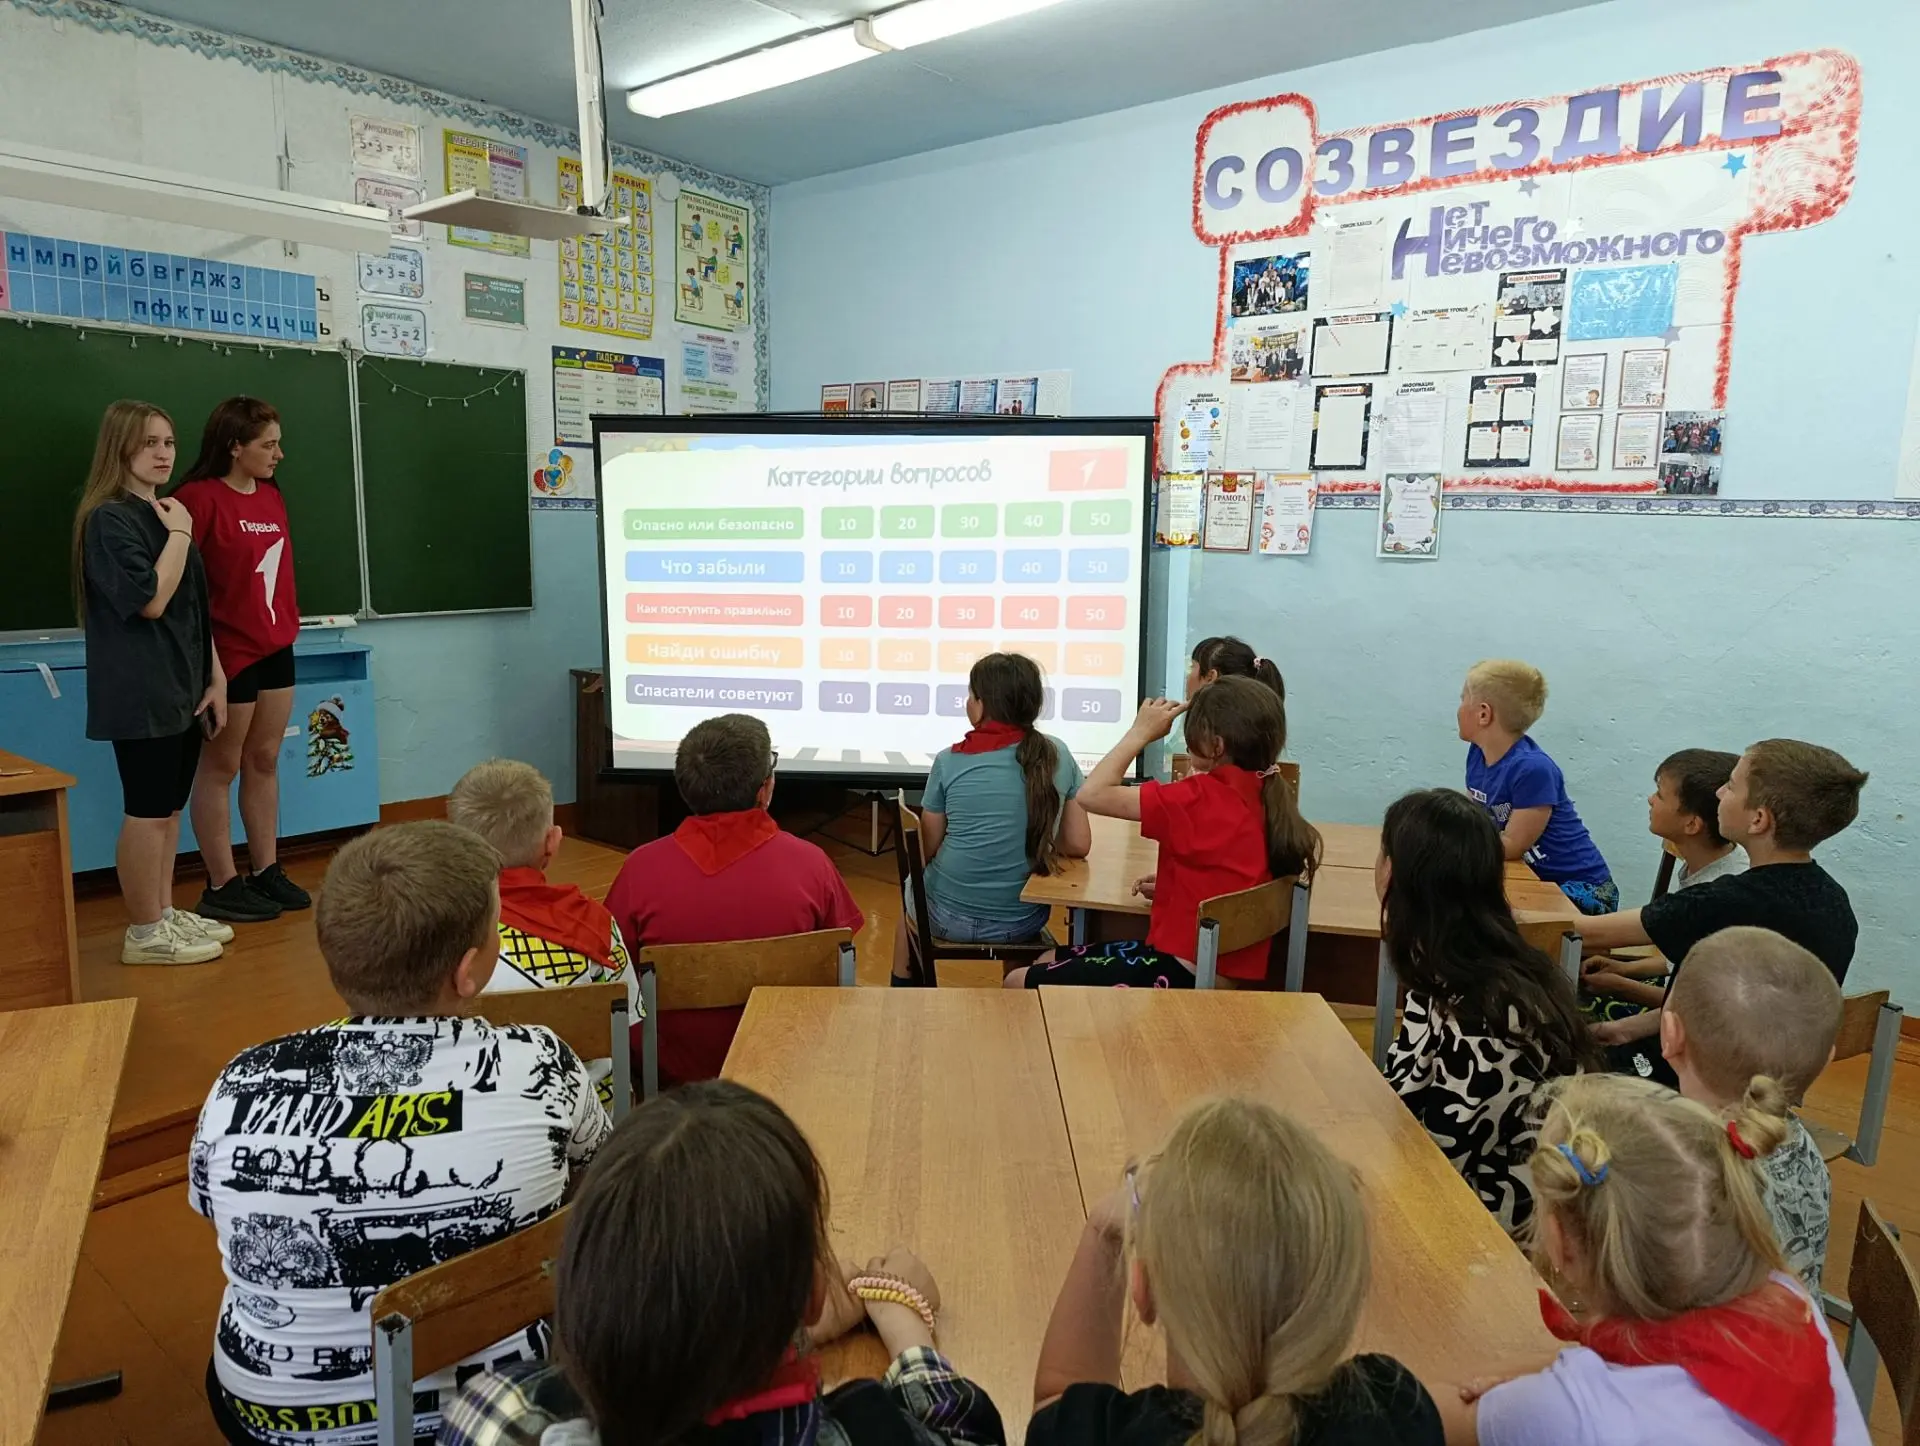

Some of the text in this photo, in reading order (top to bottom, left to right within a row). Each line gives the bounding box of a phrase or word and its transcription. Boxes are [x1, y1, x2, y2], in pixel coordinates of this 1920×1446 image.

[1204, 70, 1783, 211] СОЗВЕЗДИЕ
[613, 175, 646, 189] ЛФАВИТ
[366, 264, 373, 276] 5
[376, 268, 384, 276] +
[387, 266, 395, 279] 3
[409, 269, 417, 282] 8
[370, 325, 378, 338] 5
[391, 326, 398, 339] 3
[402, 330, 409, 338] =
[413, 329, 420, 341] 2
[596, 352, 625, 364] ПАДЕЖИ
[767, 459, 993, 492] Категории вопросов
[1213, 494, 1247, 503] ГРАМОТА
[238, 518, 281, 534] Первые
[632, 517, 795, 532] Опасно или безопасно
[838, 518, 857, 531] 10
[897, 517, 917, 530] 20
[960, 515, 979, 529] 30
[1022, 514, 1044, 528] 40
[1090, 512, 1111, 526] 50
[660, 559, 767, 575] Что забыли
[838, 562, 856, 575] 10
[897, 562, 916, 575] 20
[958, 562, 978, 575] 30
[1021, 561, 1042, 575] 40
[1087, 560, 1108, 574] 50
[636, 603, 792, 618] Как поступить правильно
[837, 606, 855, 618] 10
[896, 606, 914, 620] 20
[956, 607, 976, 621] 30
[1019, 608, 1040, 621] 40
[1085, 608, 1106, 622] 50
[647, 642, 781, 664] Найди ошибку
[894, 650, 914, 663] 20
[1083, 653, 1103, 667] 50
[634, 683, 794, 703] Спасатели советуют
[836, 692, 854, 704] 10
[894, 694, 912, 707] 20
[1081, 700, 1101, 713] 50
